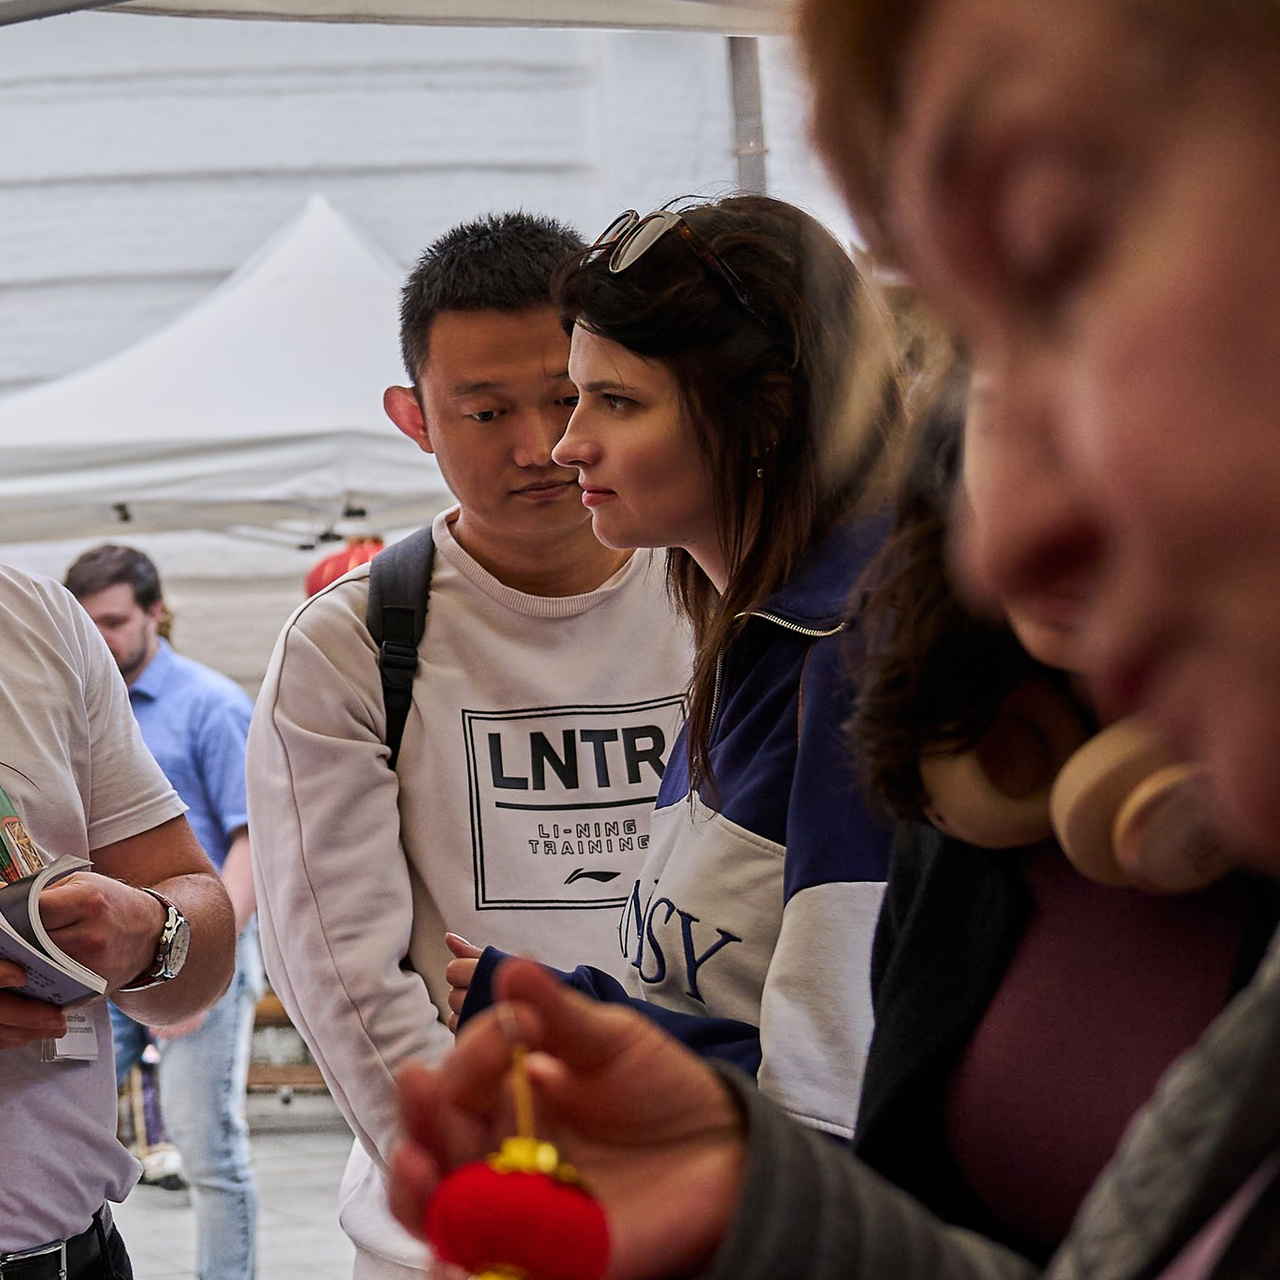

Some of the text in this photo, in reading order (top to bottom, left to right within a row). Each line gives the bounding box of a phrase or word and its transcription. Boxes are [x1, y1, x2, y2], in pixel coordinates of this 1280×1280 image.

[486, 723, 668, 792] LNTR
[537, 818, 638, 840] LI-NING
[527, 833, 651, 856] TRAINING
